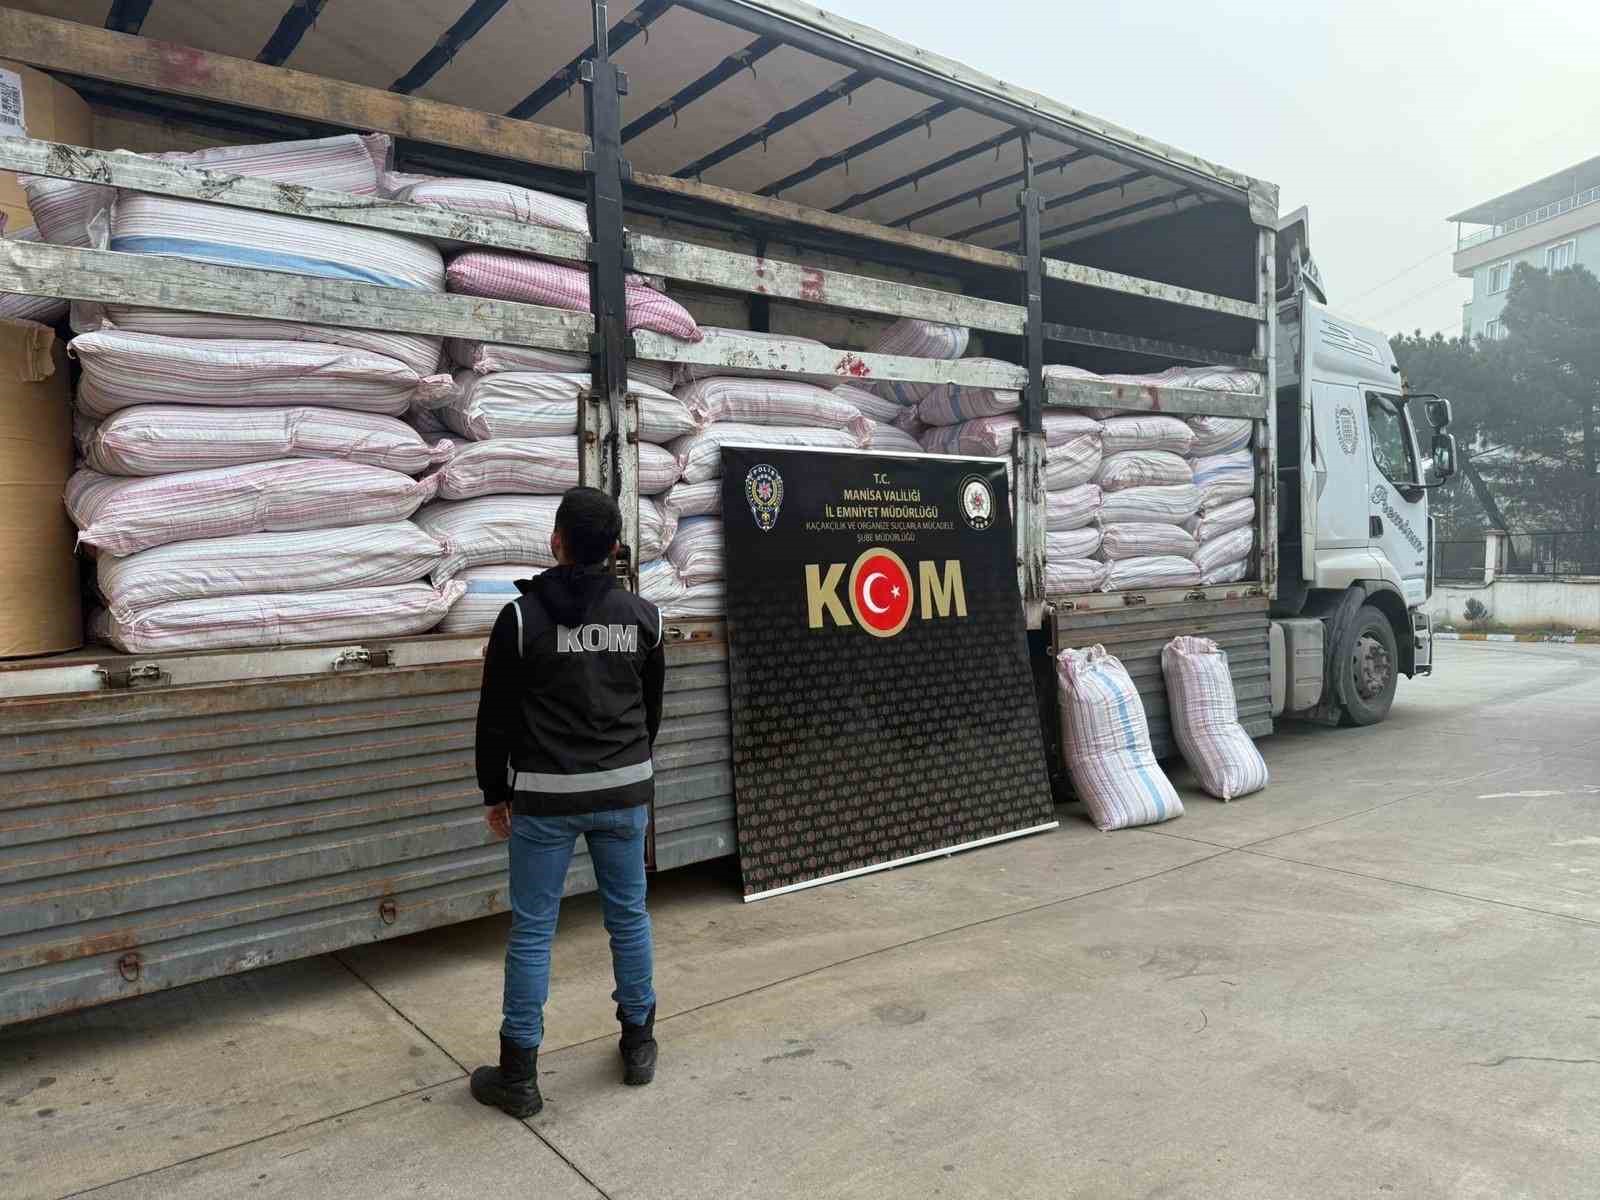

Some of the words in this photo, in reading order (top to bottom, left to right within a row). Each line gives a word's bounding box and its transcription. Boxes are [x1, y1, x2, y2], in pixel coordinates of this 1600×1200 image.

[872, 473, 890, 485] T.C.
[843, 488, 881, 501] MANİSA
[882, 488, 921, 502] VALİLİĞİ
[825, 504, 835, 518] İL
[837, 504, 878, 518] EMNİYET
[880, 504, 938, 518] MÜDÜRLÜĞÜ
[556, 624, 638, 653] KOM
